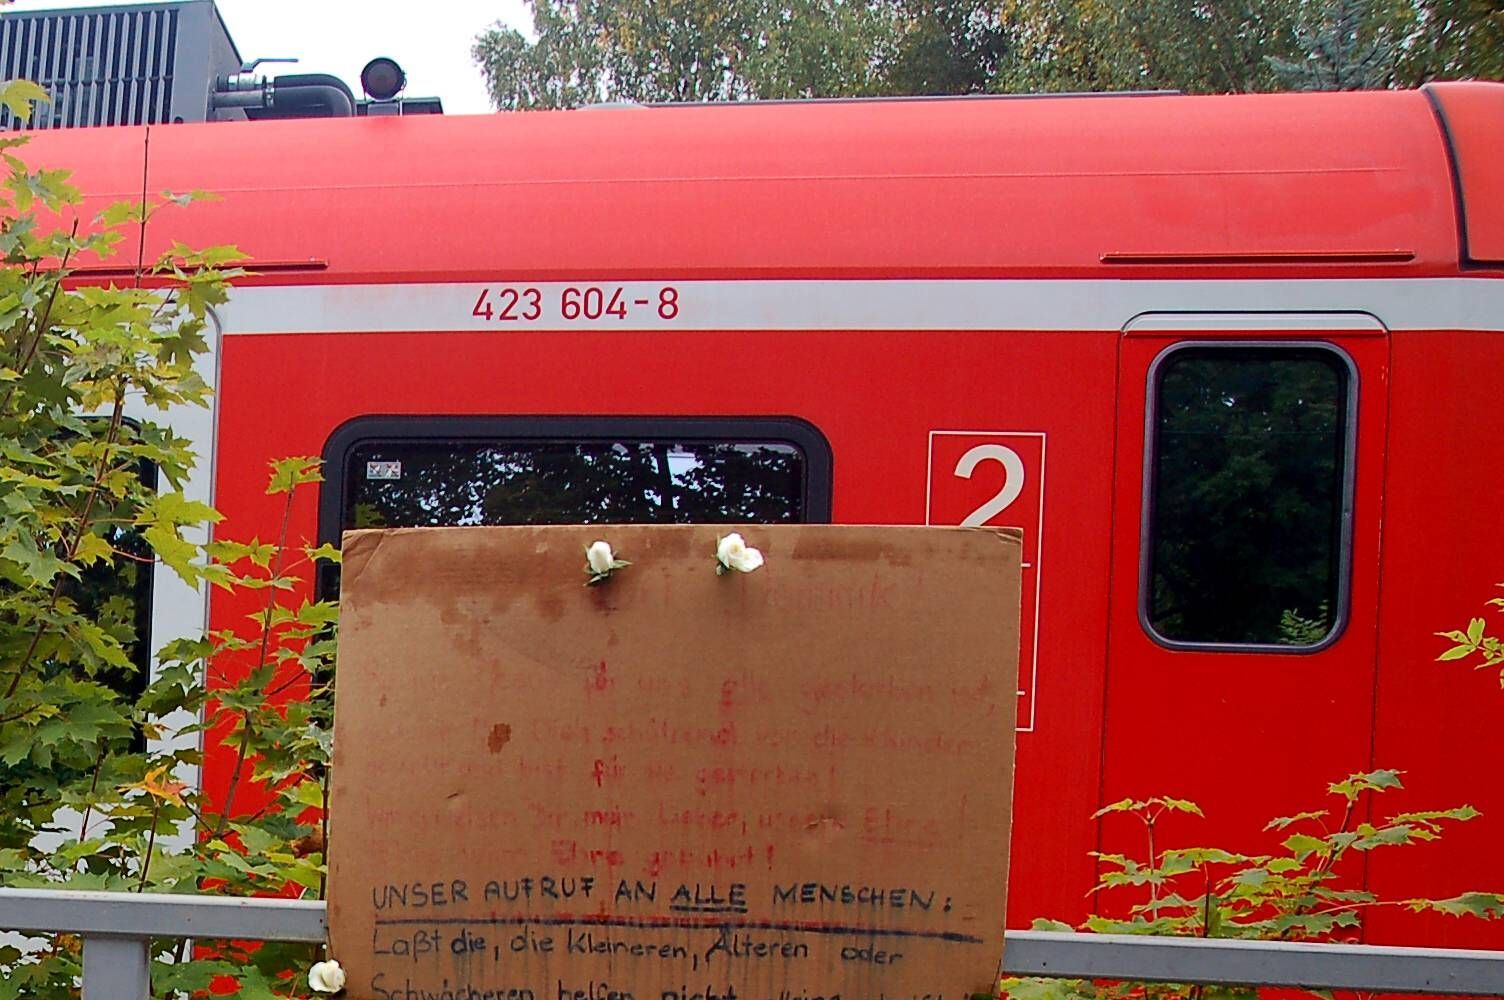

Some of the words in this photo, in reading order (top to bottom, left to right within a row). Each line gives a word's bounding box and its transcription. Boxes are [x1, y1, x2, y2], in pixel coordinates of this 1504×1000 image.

[471, 288, 543, 321] 423
[560, 286, 680, 320] 604-8
[953, 443, 1025, 527] 2
[372, 878, 469, 910] UNSER
[483, 876, 595, 902] AUFRUF
[614, 879, 657, 904] AN
[672, 881, 747, 908] ALLE
[509, 925, 554, 953] die
[840, 942, 904, 966] oder
